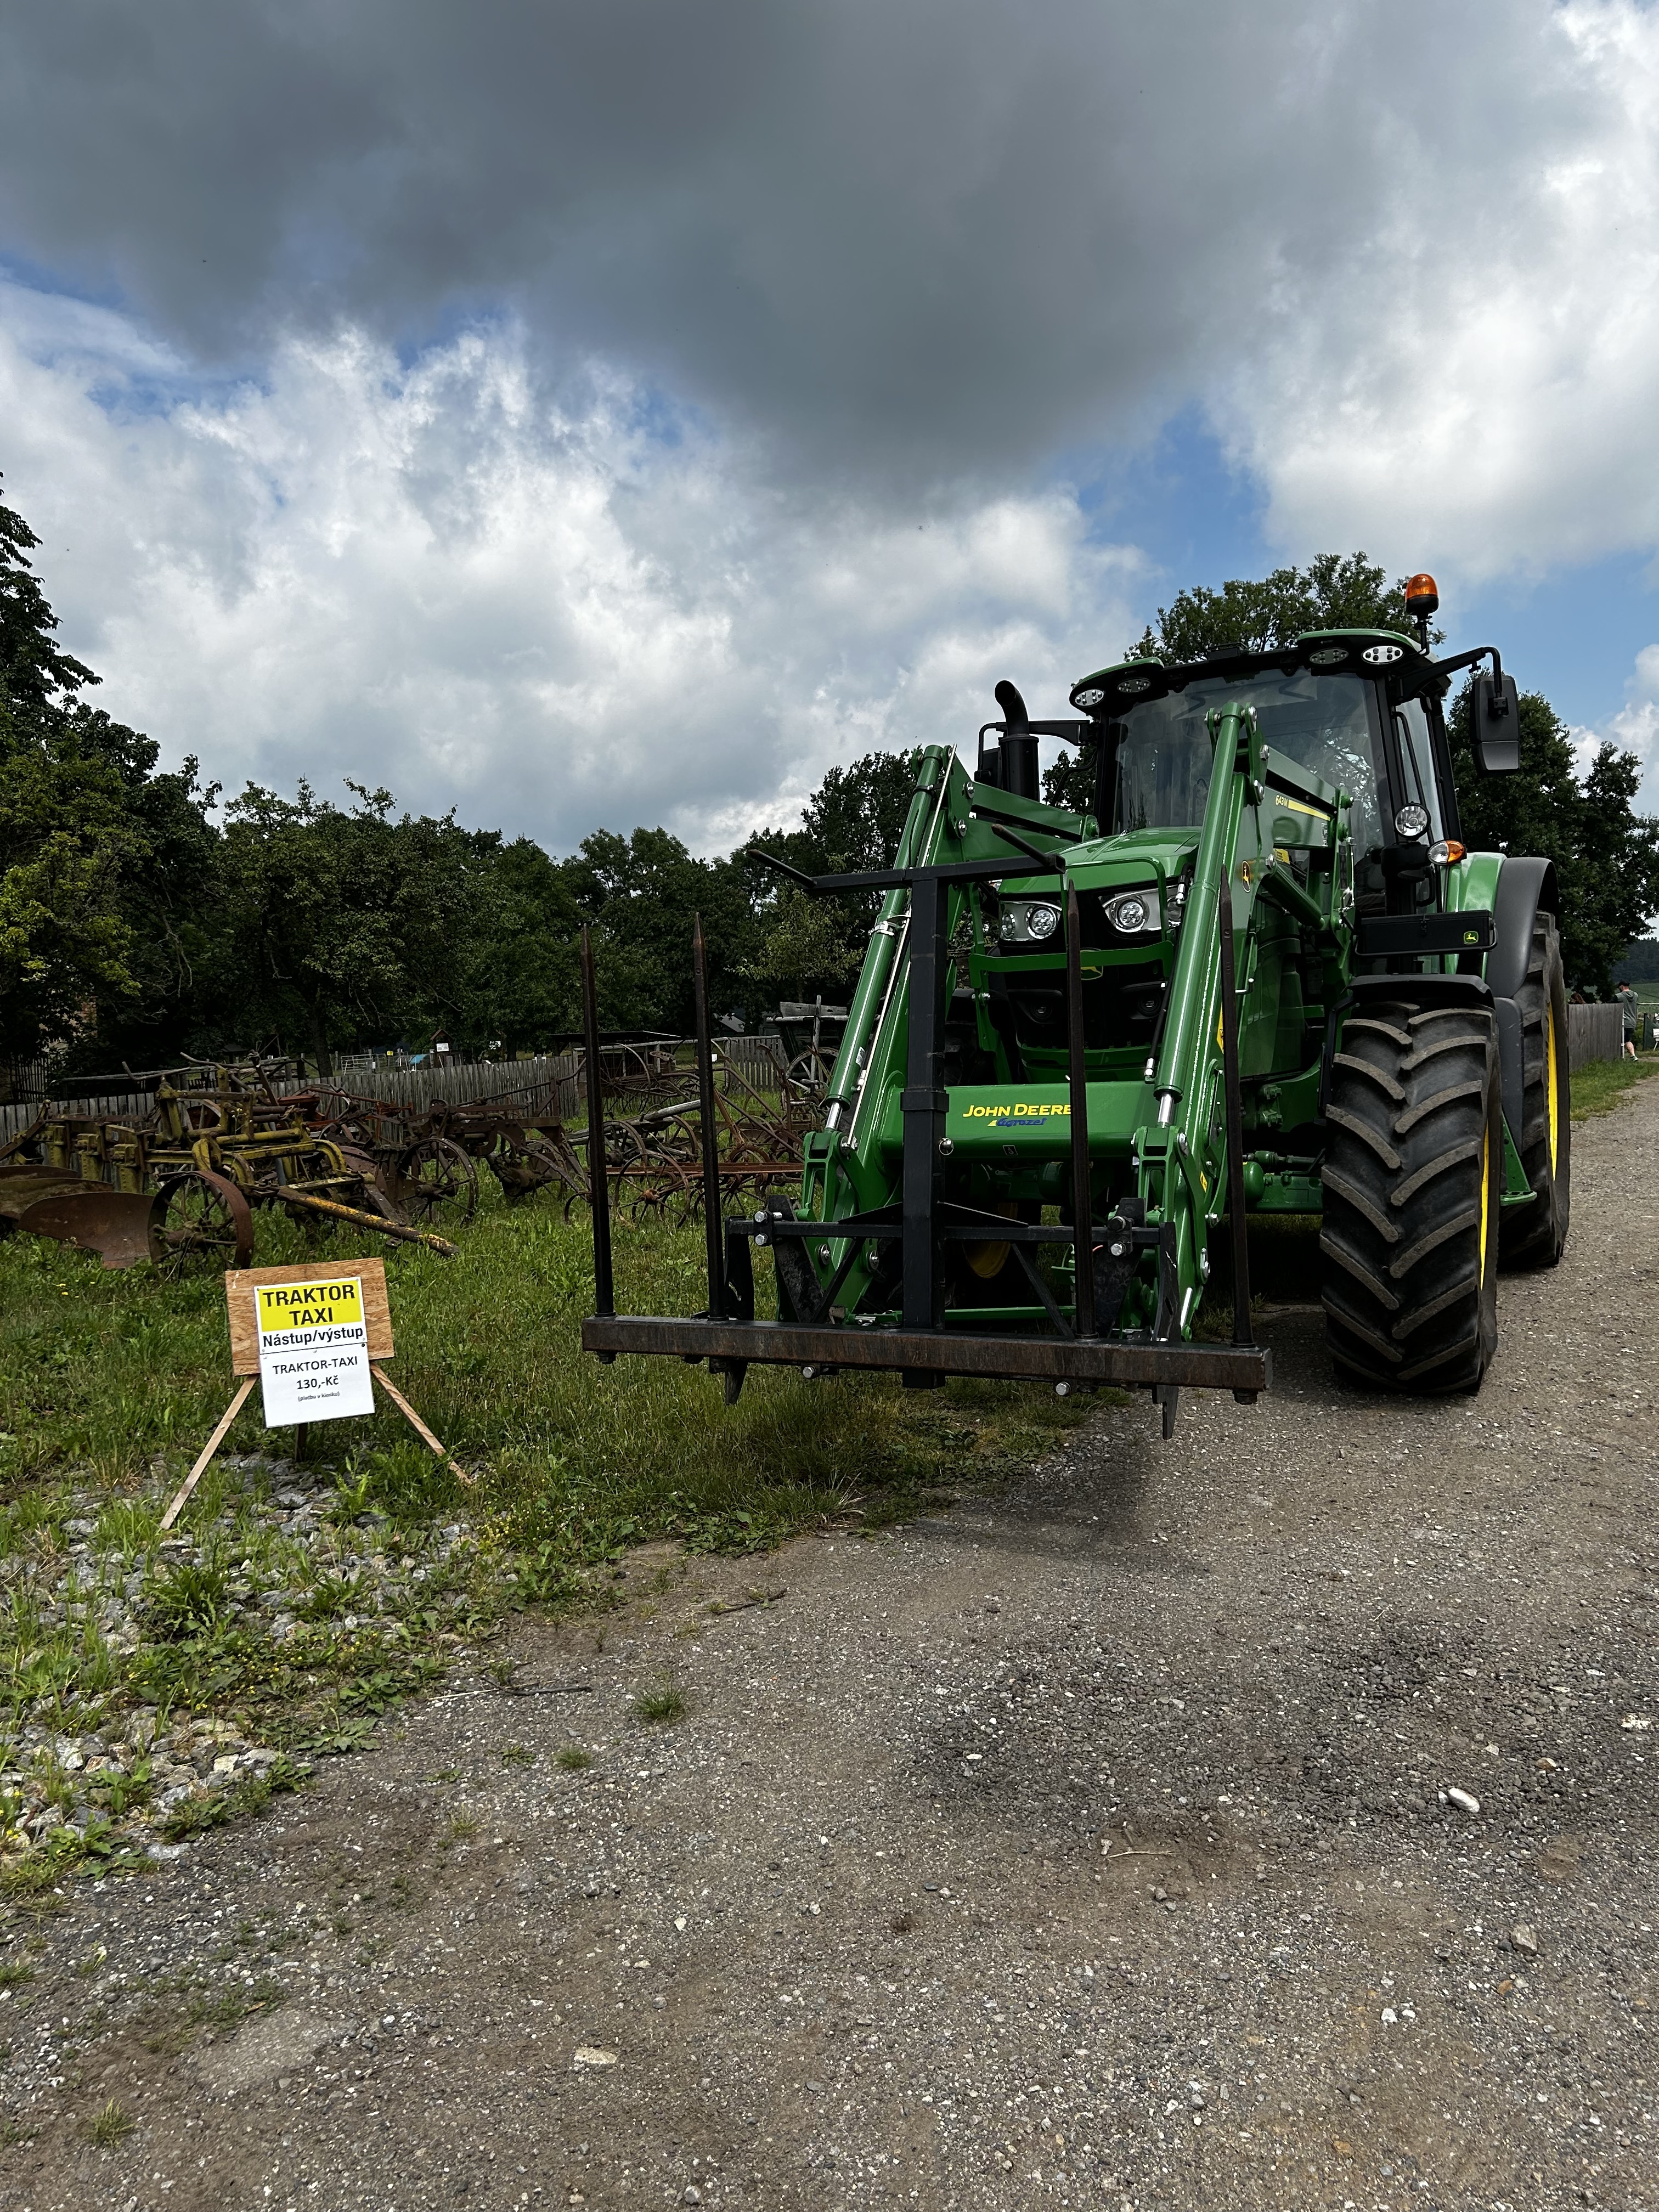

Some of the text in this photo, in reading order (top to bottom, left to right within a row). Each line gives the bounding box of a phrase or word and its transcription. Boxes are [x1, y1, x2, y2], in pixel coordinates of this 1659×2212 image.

[963, 1105, 1011, 1117] JOHN
[263, 1284, 355, 1307] TRAKTOR
[289, 1307, 334, 1326] TAXI
[263, 1327, 363, 1347] Nástup/výstup
[273, 1356, 358, 1375] TRAKTOR-TAXI
[297, 1375, 339, 1390] 130,-Kč
